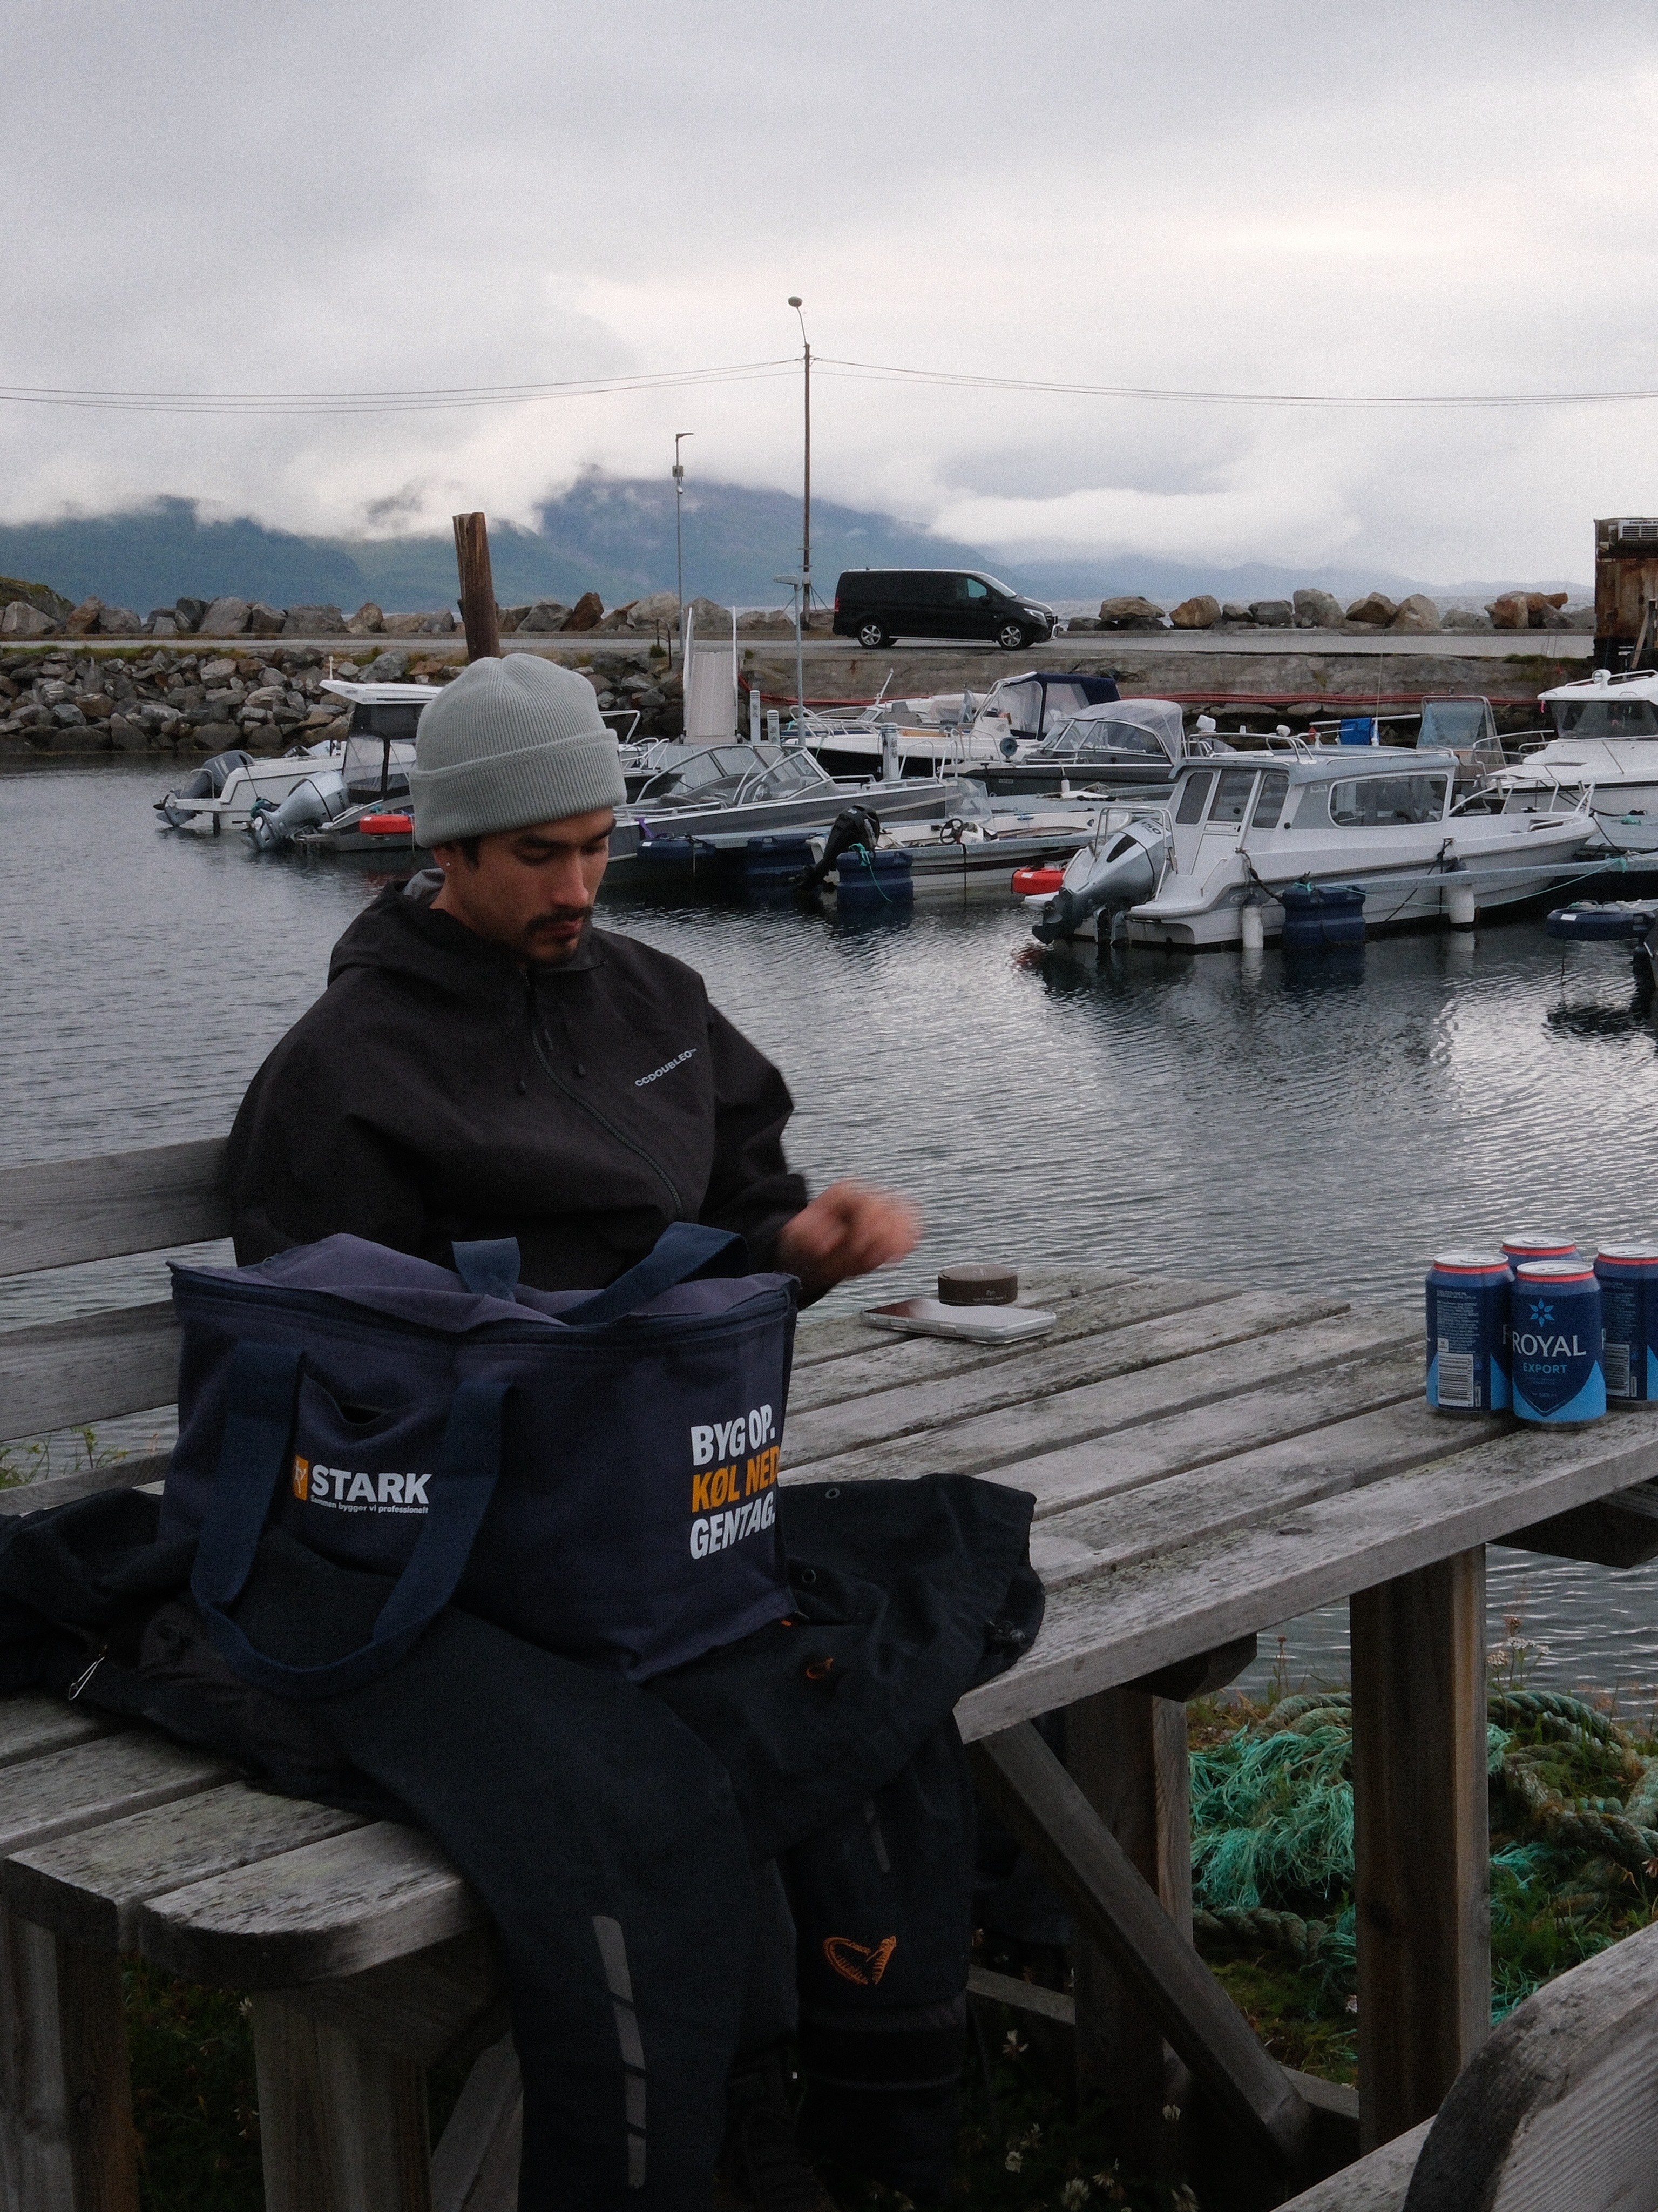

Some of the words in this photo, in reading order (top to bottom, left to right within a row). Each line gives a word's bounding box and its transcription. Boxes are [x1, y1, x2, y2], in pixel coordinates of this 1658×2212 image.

[1512, 1330, 1587, 1357] ROYAL
[1522, 1361, 1567, 1374] EXPORT
[691, 1416, 746, 1466] BYG
[748, 1404, 775, 1449] OP.
[310, 1464, 432, 1505] STARK
[692, 1464, 740, 1513] KØL
[338, 1502, 367, 1513] bygger
[378, 1506, 429, 1514] professionelt
